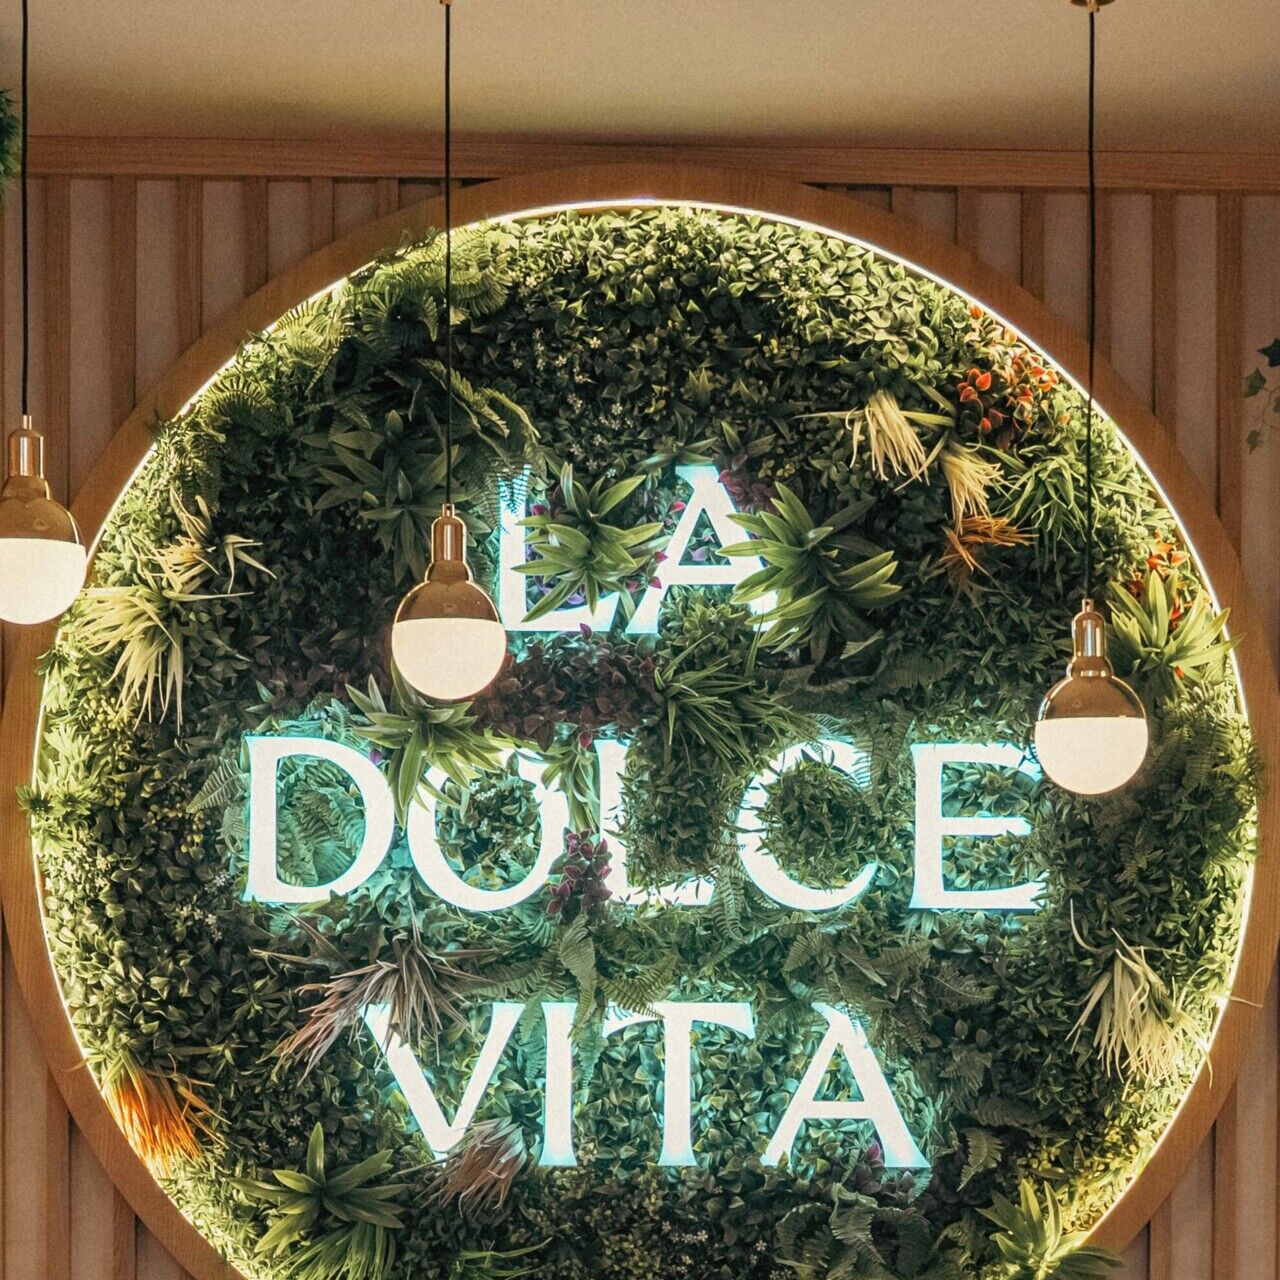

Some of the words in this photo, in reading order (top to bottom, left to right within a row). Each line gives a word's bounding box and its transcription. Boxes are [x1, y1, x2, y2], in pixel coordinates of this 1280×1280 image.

[497, 463, 796, 635] LA
[243, 734, 1049, 912] DOLCE
[357, 999, 932, 1169] VITA
